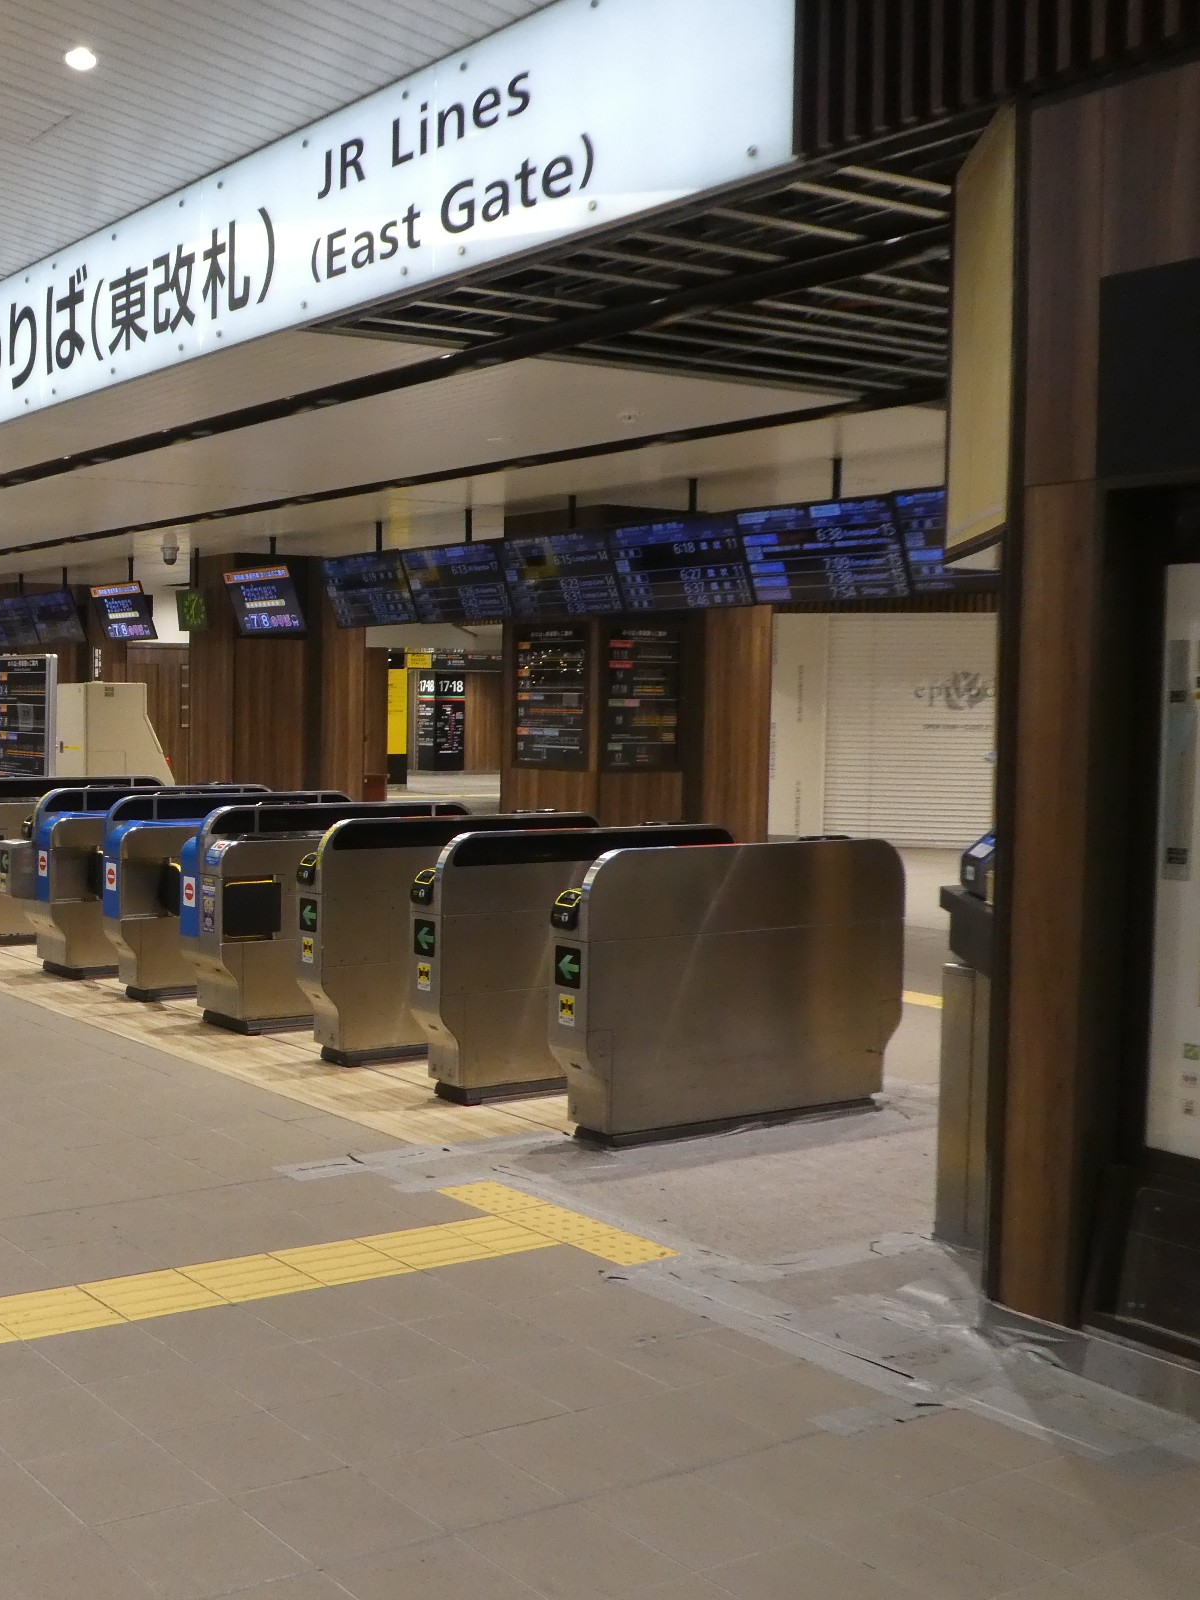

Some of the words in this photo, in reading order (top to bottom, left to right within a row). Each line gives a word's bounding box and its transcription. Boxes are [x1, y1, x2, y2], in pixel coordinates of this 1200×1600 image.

[317, 138, 366, 200] JR
[391, 70, 531, 168] Lines
[311, 203, 421, 283] (East
[440, 132, 594, 234] Gate)
